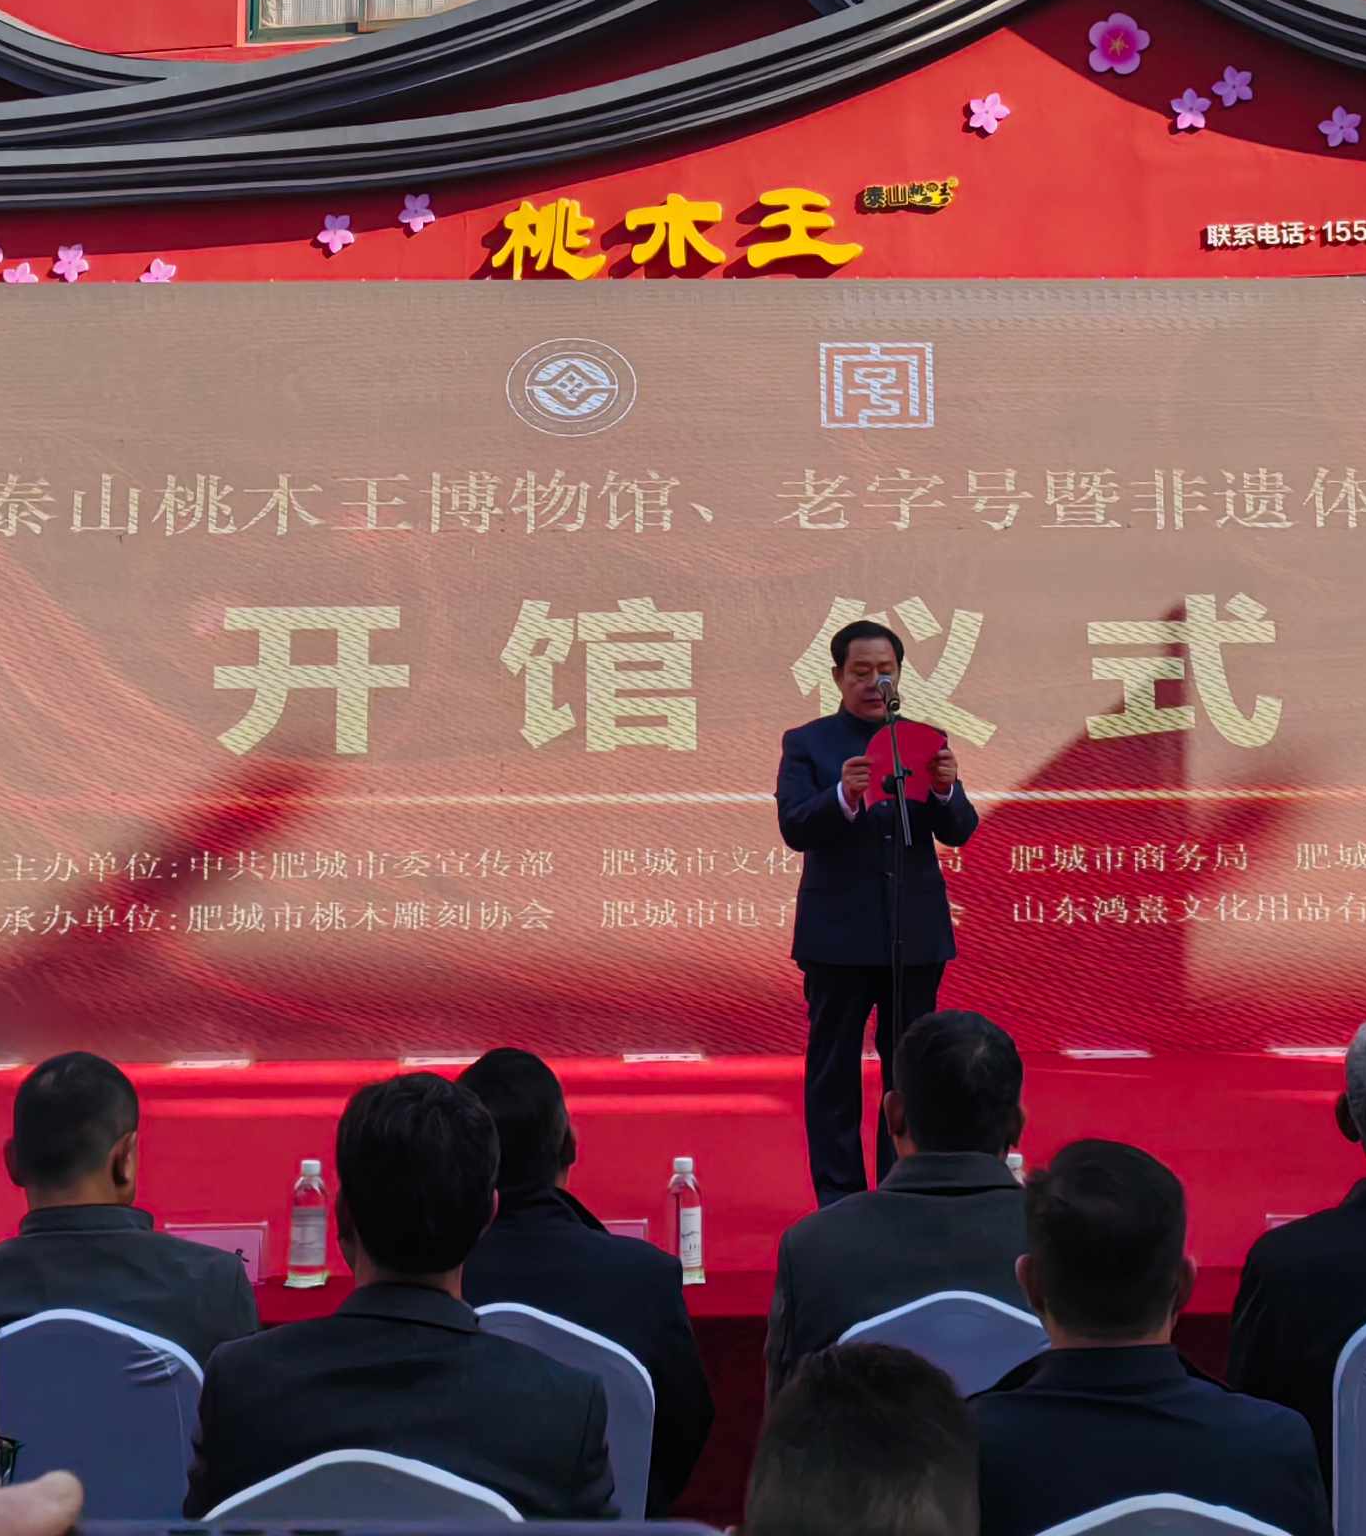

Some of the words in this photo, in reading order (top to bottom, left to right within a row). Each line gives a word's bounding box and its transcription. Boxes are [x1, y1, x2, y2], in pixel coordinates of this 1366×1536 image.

[491, 187, 864, 280] 桃木王
[213, 593, 1283, 756] 开馆仪式
[1008, 842, 1248, 874] 肥城市商务局
